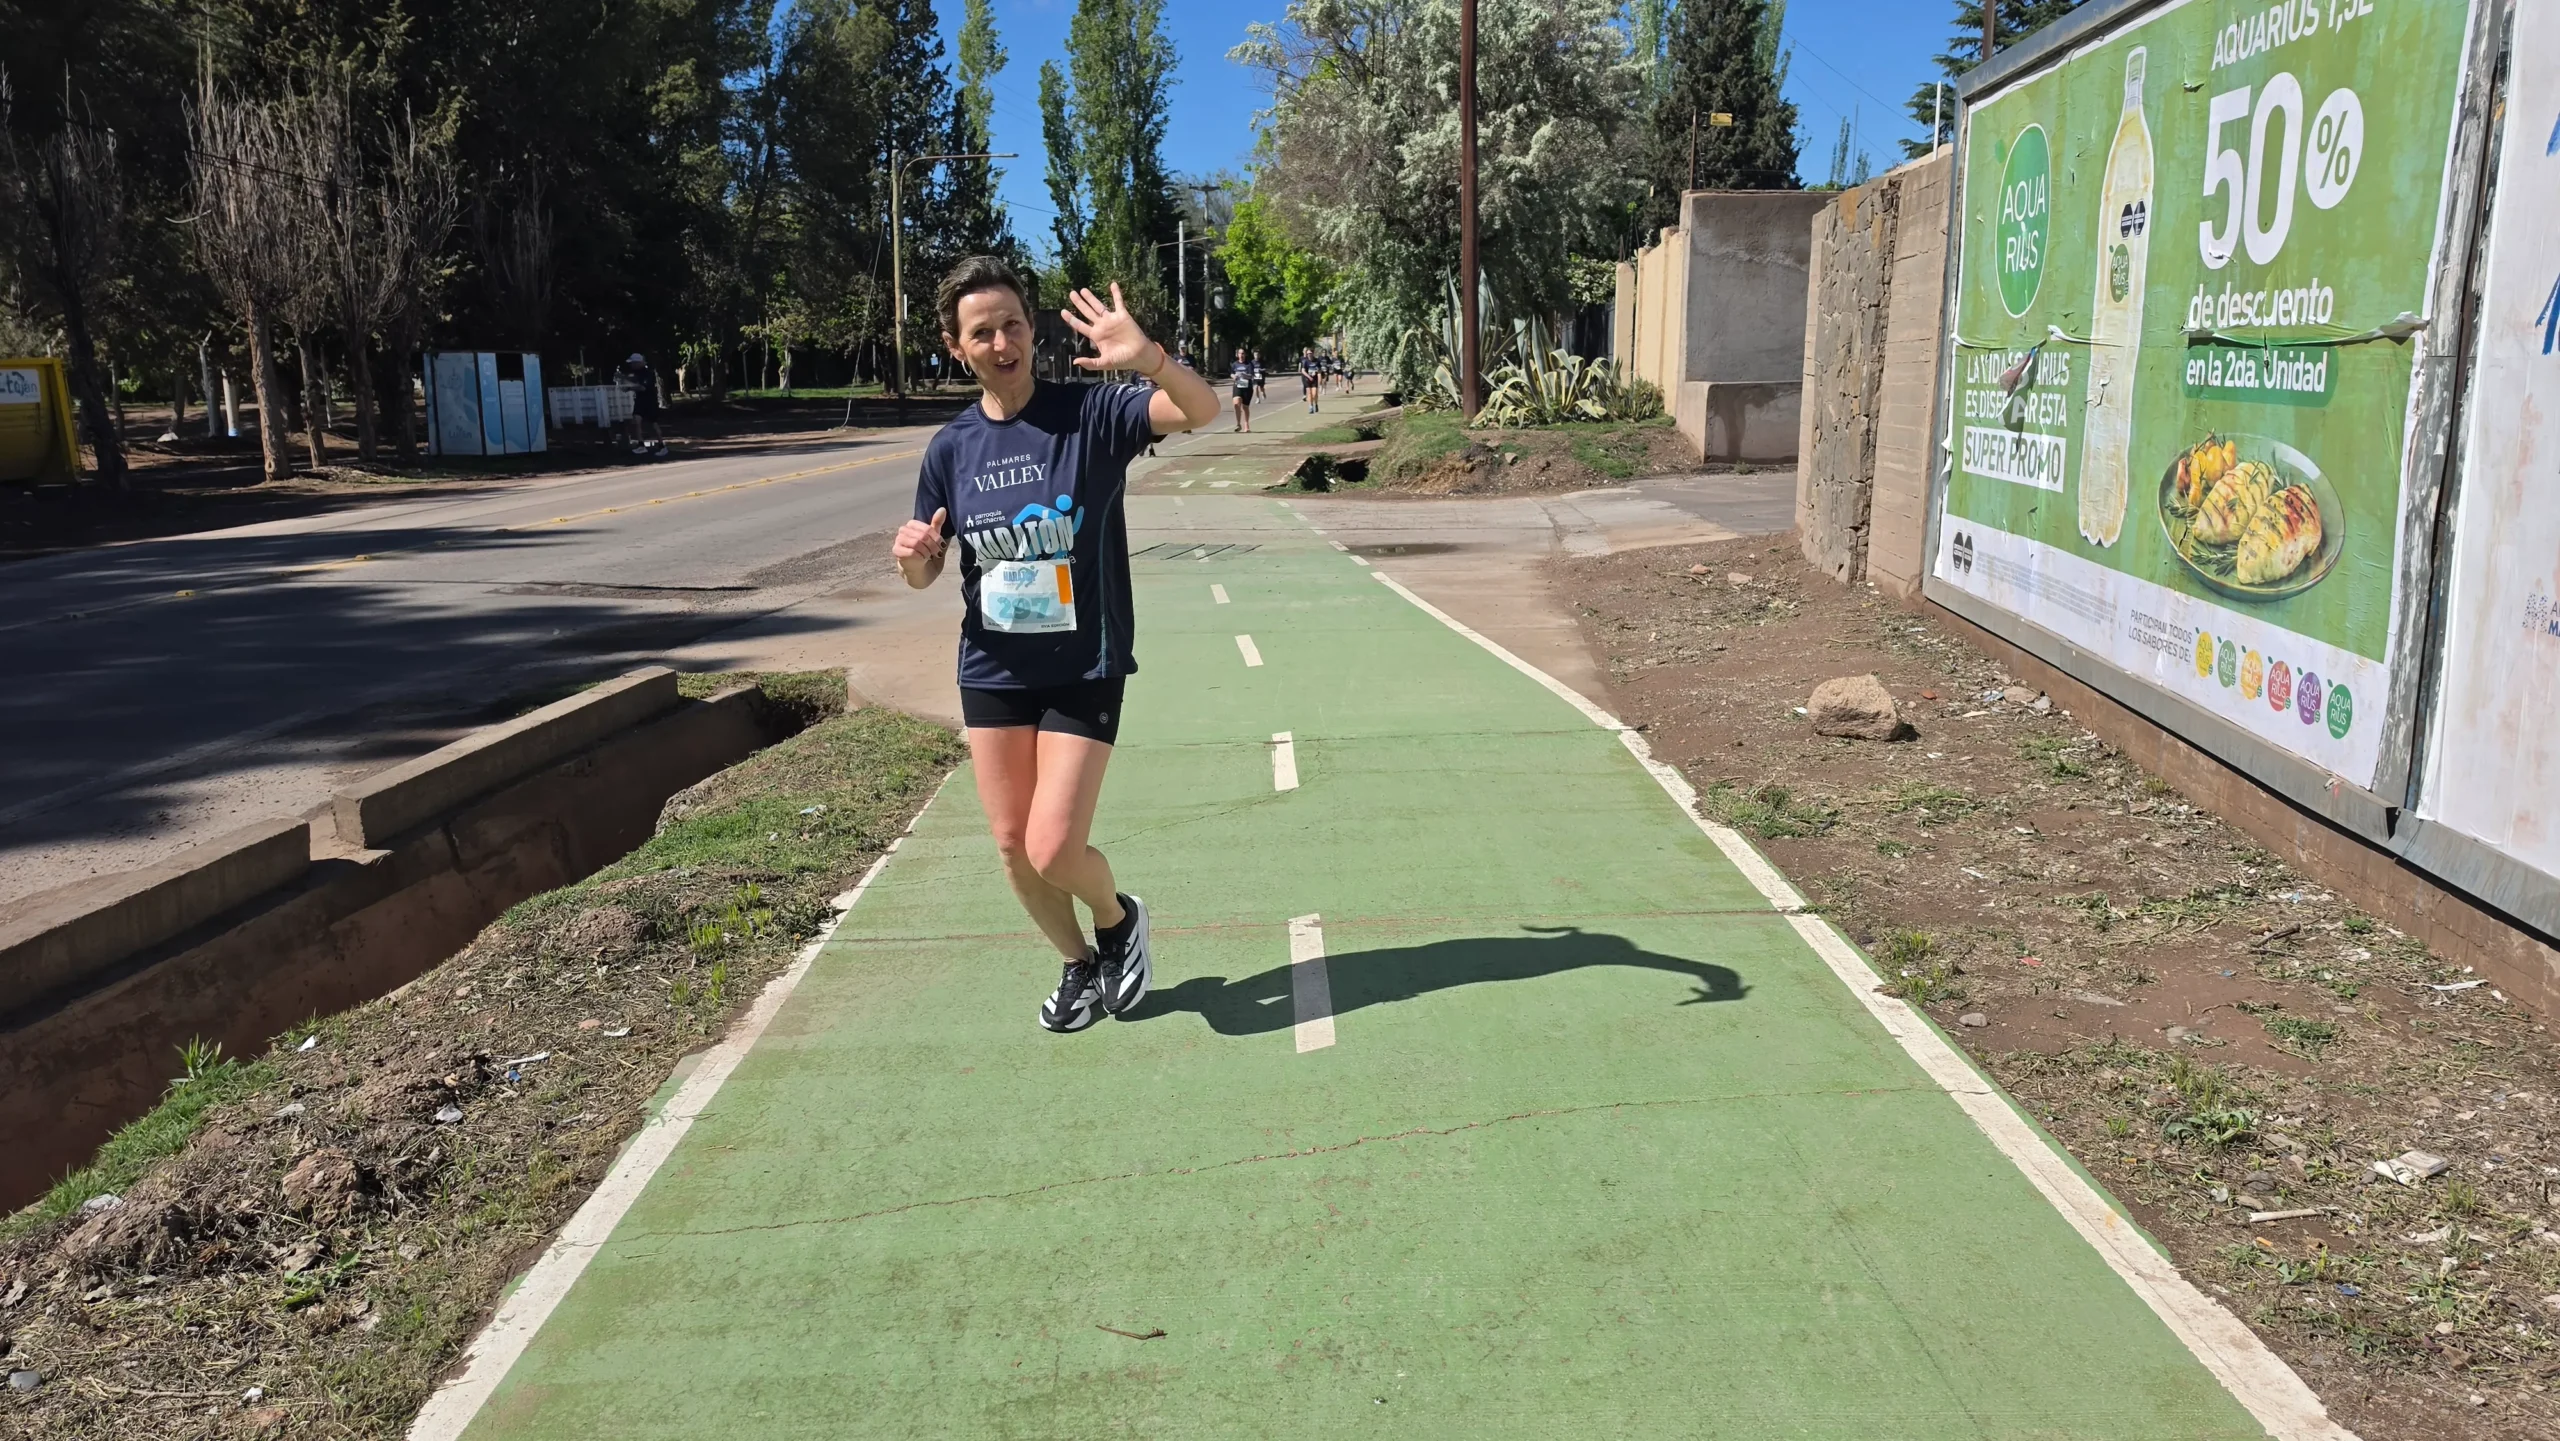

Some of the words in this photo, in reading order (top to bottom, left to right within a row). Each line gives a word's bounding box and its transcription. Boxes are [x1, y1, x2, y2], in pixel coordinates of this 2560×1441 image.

[2211, 0, 2320, 71] AQUARIUS
[2002, 173, 2046, 226] AQUA
[2005, 230, 2039, 274] RIUS
[2188, 283, 2214, 329] de
[2216, 277, 2334, 328] descuento
[1967, 354, 1980, 384] LA
[2186, 358, 2206, 386] en
[2207, 350, 2223, 387] la
[2224, 350, 2260, 388] 2da.
[2263, 350, 2328, 393] Unidad
[1965, 389, 1978, 418] ES
[2039, 392, 2068, 427] ESTA
[986, 454, 1031, 468] PALMARES
[1964, 431, 2007, 473] SUPER
[974, 463, 1046, 493] VALLEY
[974, 509, 1002, 521] parroquia
[983, 515, 1006, 525] chacras
[997, 596, 1050, 620] 297
[2128, 625, 2142, 642] LOS
[2142, 632, 2178, 658] SABORES
[2169, 623, 2193, 645] TODOS
[2220, 647, 2236, 662] AQUA
[2270, 668, 2290, 686] AQUA
[2300, 680, 2320, 698] AQUA
[2330, 692, 2351, 711] AQUA
